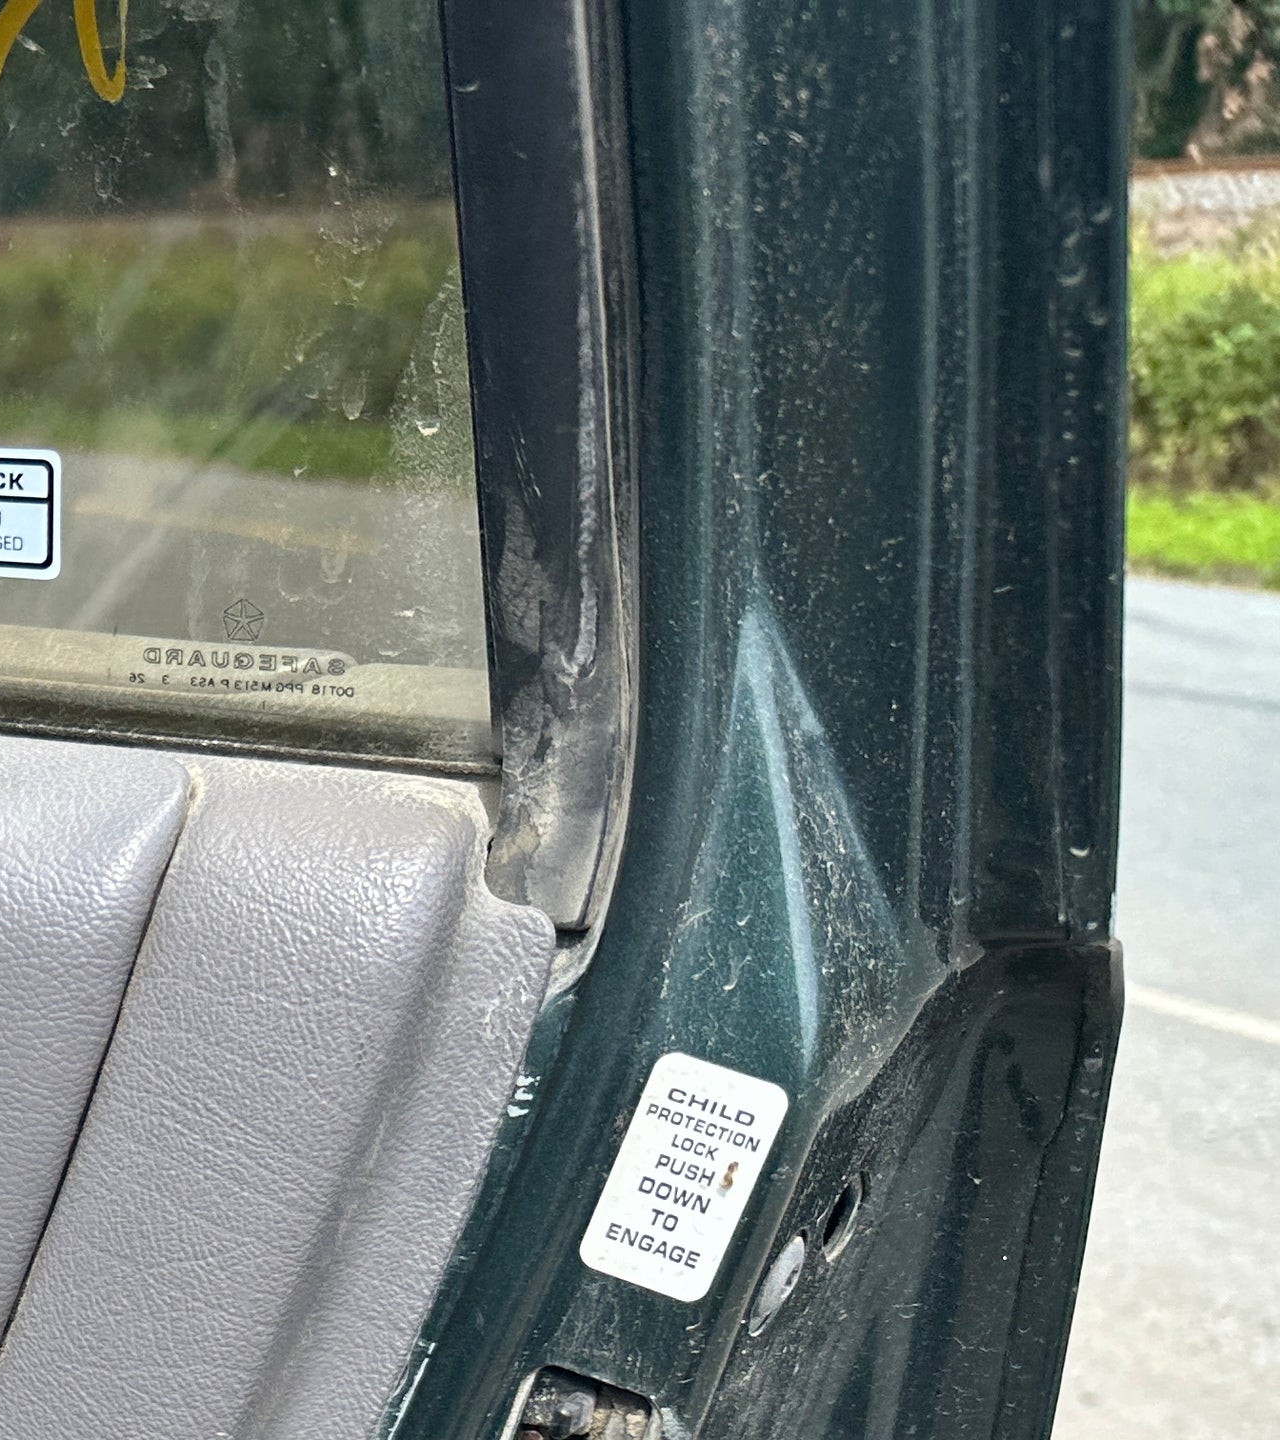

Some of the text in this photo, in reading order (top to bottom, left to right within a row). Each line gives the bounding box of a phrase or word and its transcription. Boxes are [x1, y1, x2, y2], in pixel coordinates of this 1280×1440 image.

[667, 1087, 755, 1126] CHILD
[646, 1104, 761, 1152] PROTECTION
[671, 1134, 719, 1161] LOCK
[655, 1154, 715, 1186] PUSH
[637, 1177, 711, 1214] DOWN
[651, 1208, 678, 1231] TO
[605, 1223, 701, 1269] ENGAGE
